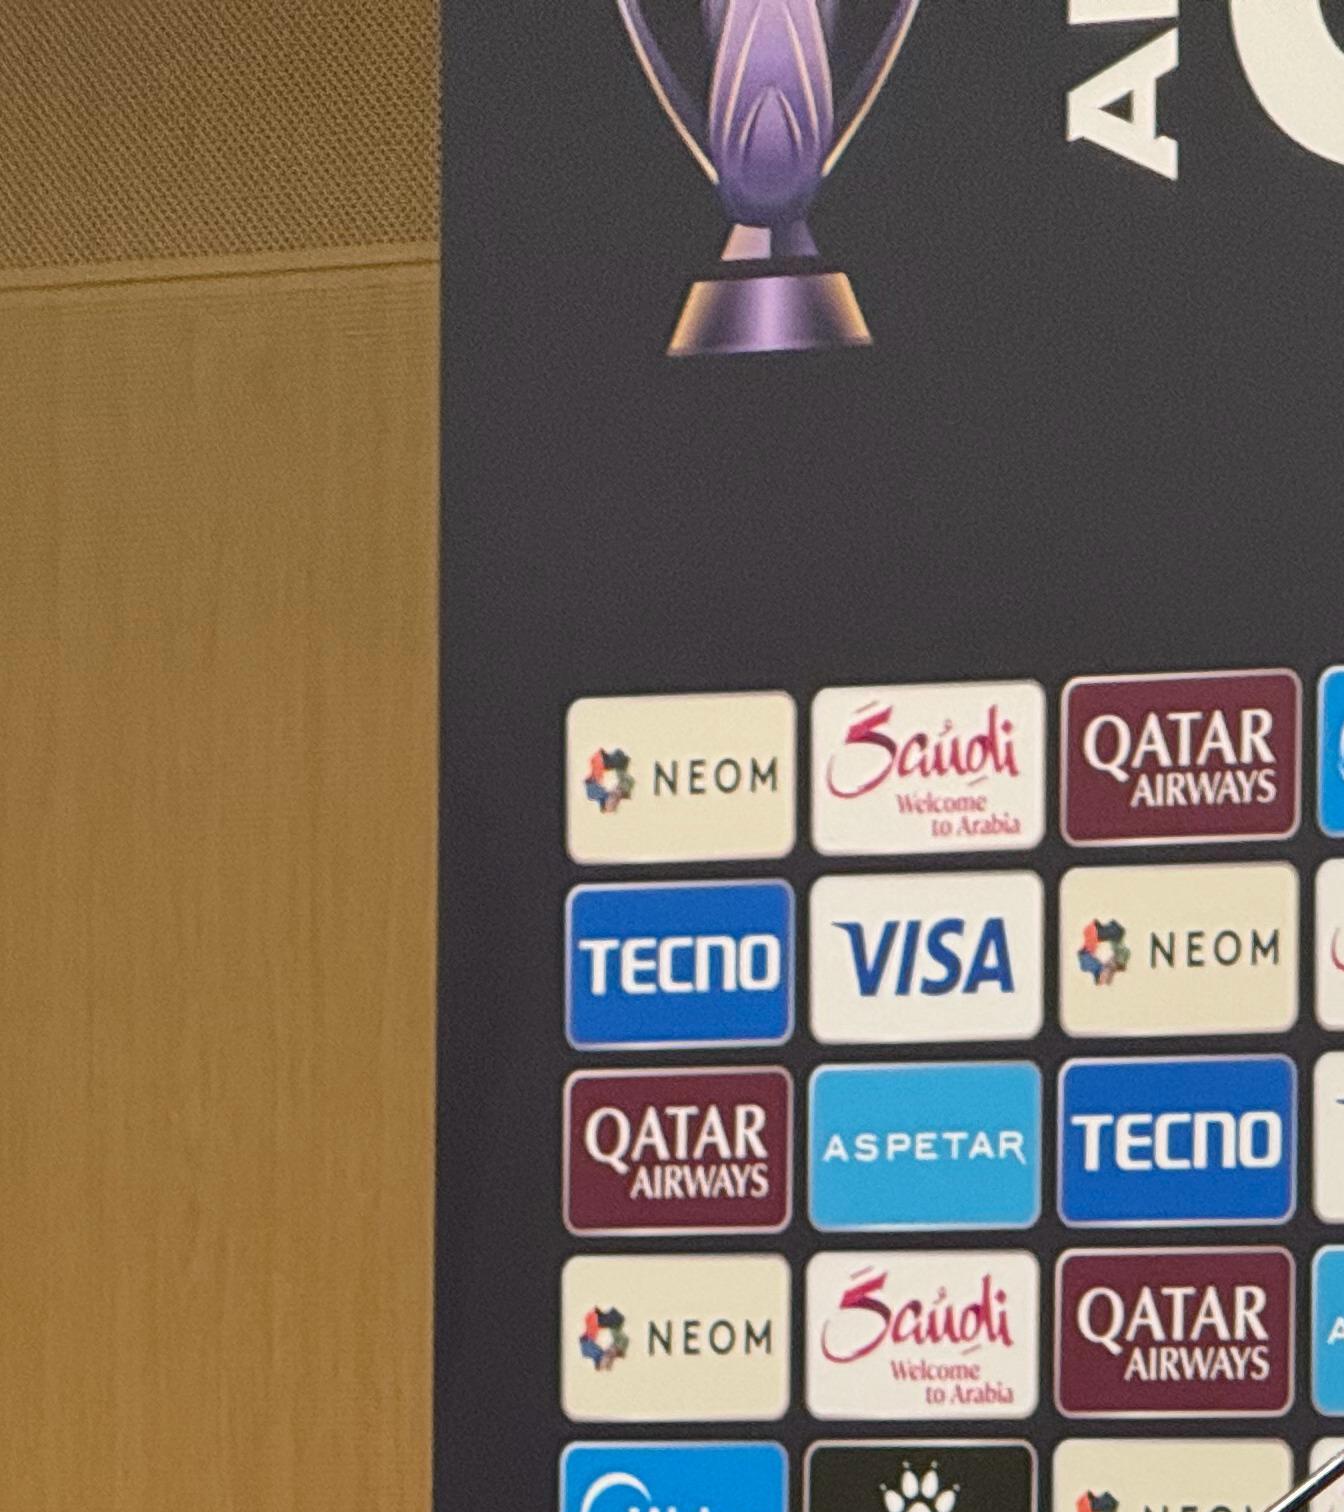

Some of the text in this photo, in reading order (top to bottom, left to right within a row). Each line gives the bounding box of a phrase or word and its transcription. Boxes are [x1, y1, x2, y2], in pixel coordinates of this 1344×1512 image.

[826, 701, 1021, 799] Saudi
[1083, 708, 1277, 781] QATAR
[654, 757, 778, 796] NEOM
[1130, 768, 1278, 809] AIRWAYS
[897, 794, 987, 815] Welcome
[932, 813, 1022, 837] to Arabia
[578, 934, 781, 995] TECNO
[832, 917, 1015, 997] VISA
[1149, 929, 1281, 968] NEOM
[584, 1105, 769, 1174] QATAR
[823, 1131, 1027, 1165] ASPETAR
[1071, 1111, 1283, 1173] TECNO
[630, 1163, 769, 1200] AIRWAYS
[820, 1266, 1015, 1364] Saudi
[1077, 1285, 1269, 1356] QATAR
[648, 1320, 773, 1355] NEOM
[891, 1360, 981, 1381] Welcome
[1125, 1345, 1270, 1382] AIRWAYS
[925, 1384, 1015, 1405] to Arabia
